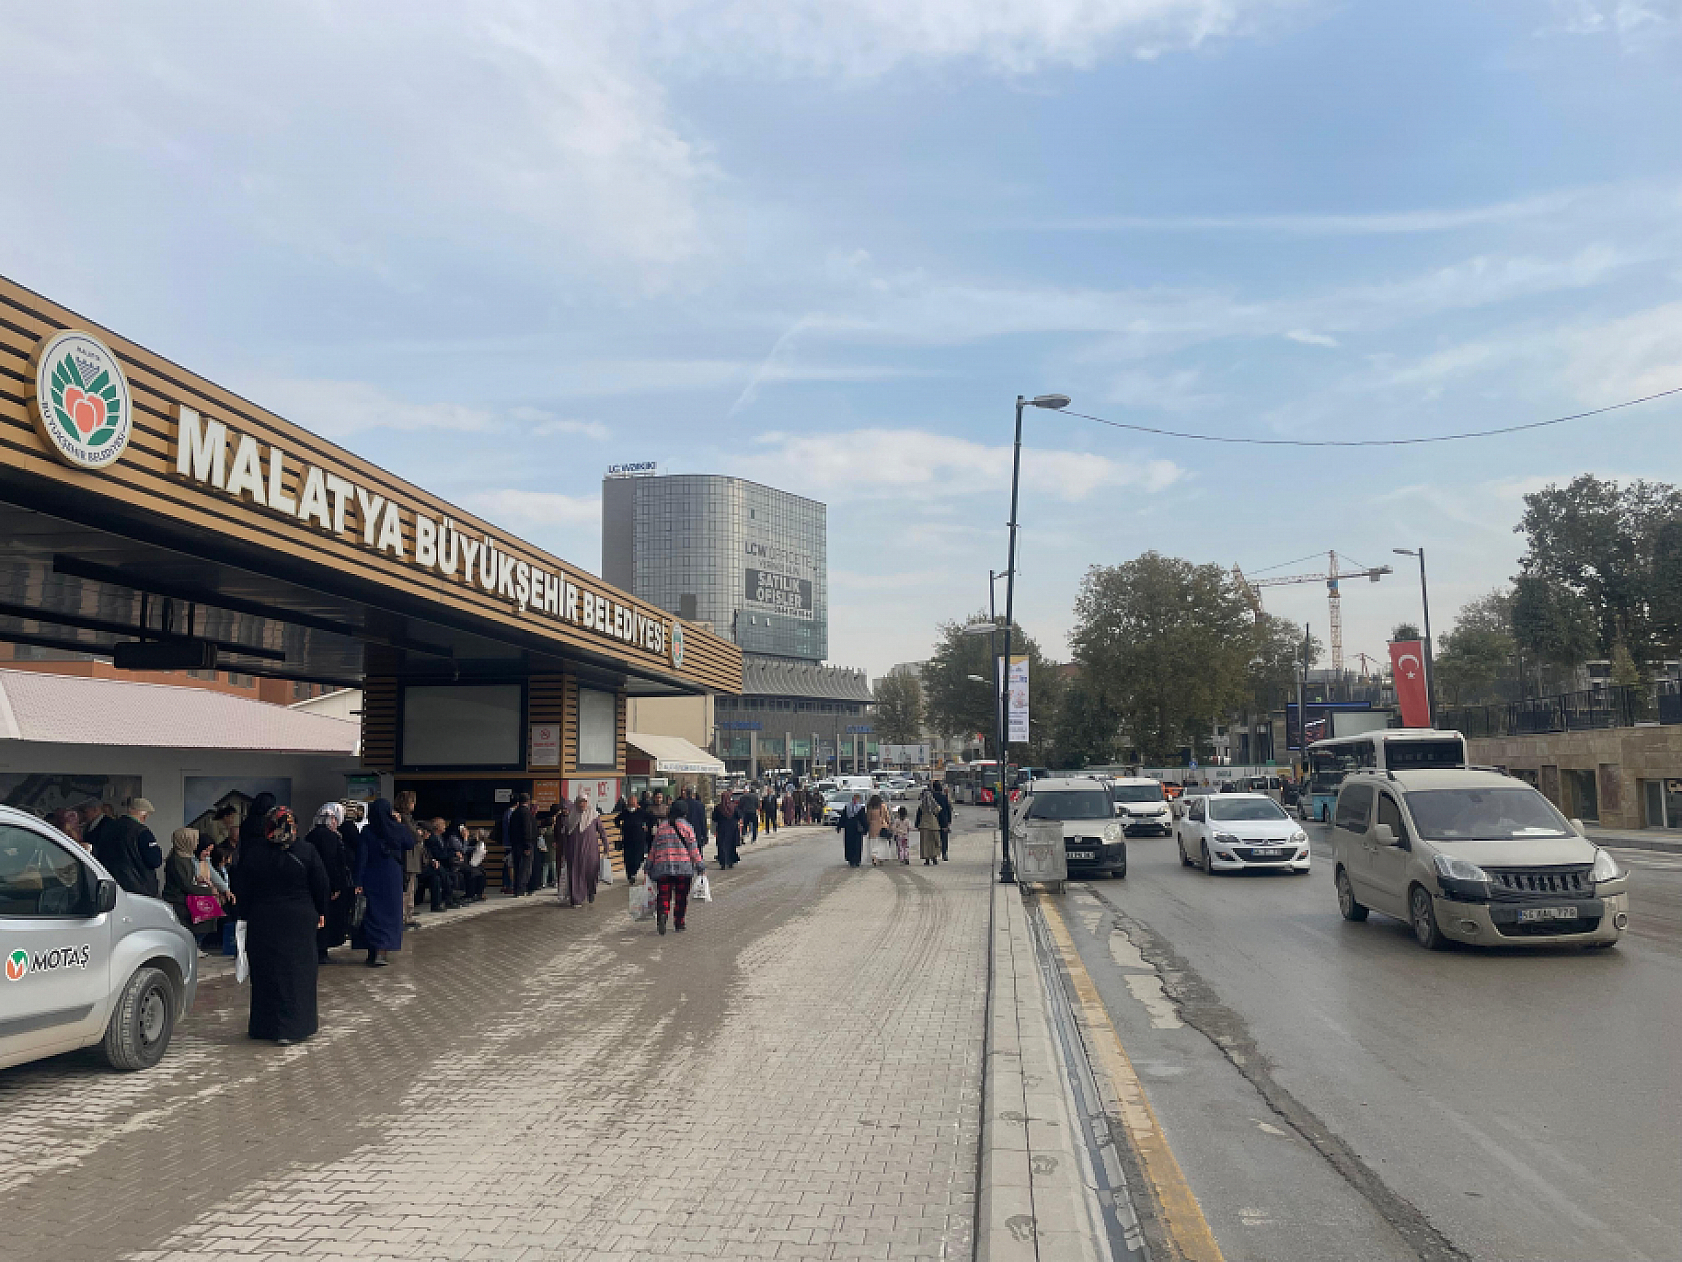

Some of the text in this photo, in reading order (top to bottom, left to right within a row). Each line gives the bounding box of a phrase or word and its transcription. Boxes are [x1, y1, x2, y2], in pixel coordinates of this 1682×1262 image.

[176, 404, 665, 653] MALATYA BÜYÜKŞEHİR BELEDİYESİ
[29, 944, 91, 973] MOTAŞ
